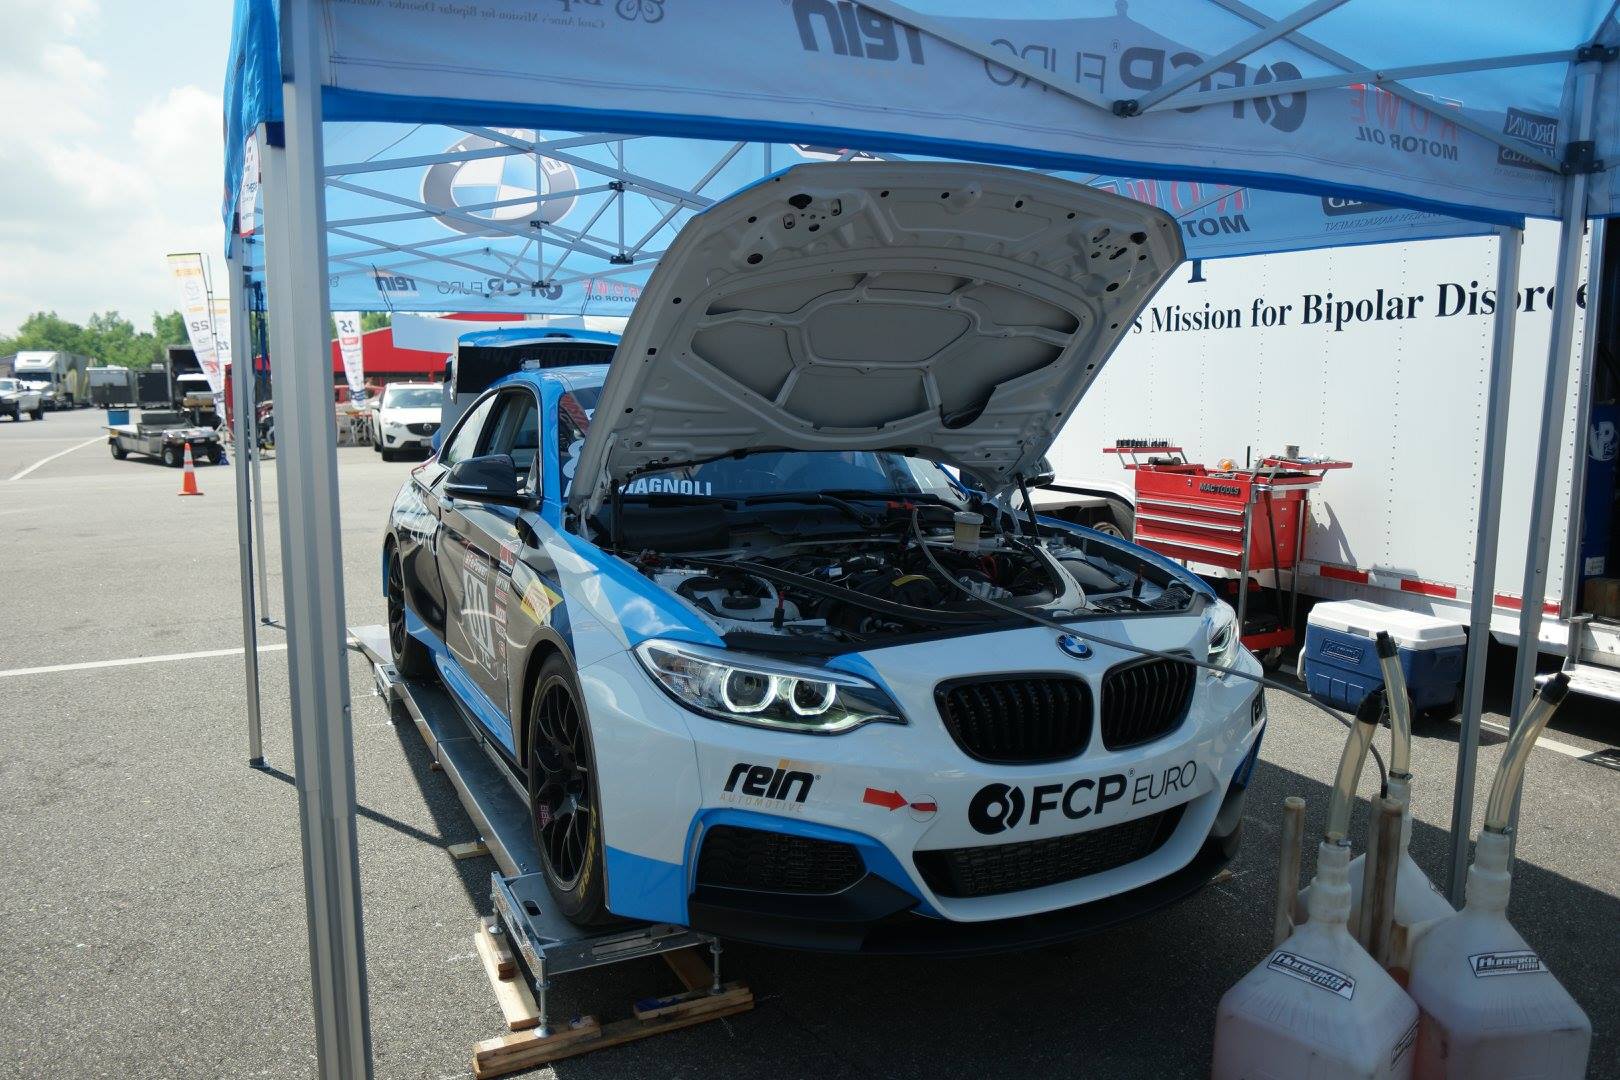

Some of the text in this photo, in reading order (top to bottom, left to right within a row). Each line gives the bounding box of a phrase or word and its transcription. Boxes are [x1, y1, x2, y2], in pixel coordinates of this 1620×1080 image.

[1150, 303, 1241, 333] Mission
[1250, 298, 1292, 328] for
[1300, 289, 1422, 332] Bipolar
[723, 761, 815, 803] rein
[1029, 760, 1197, 825] FCP EURO
